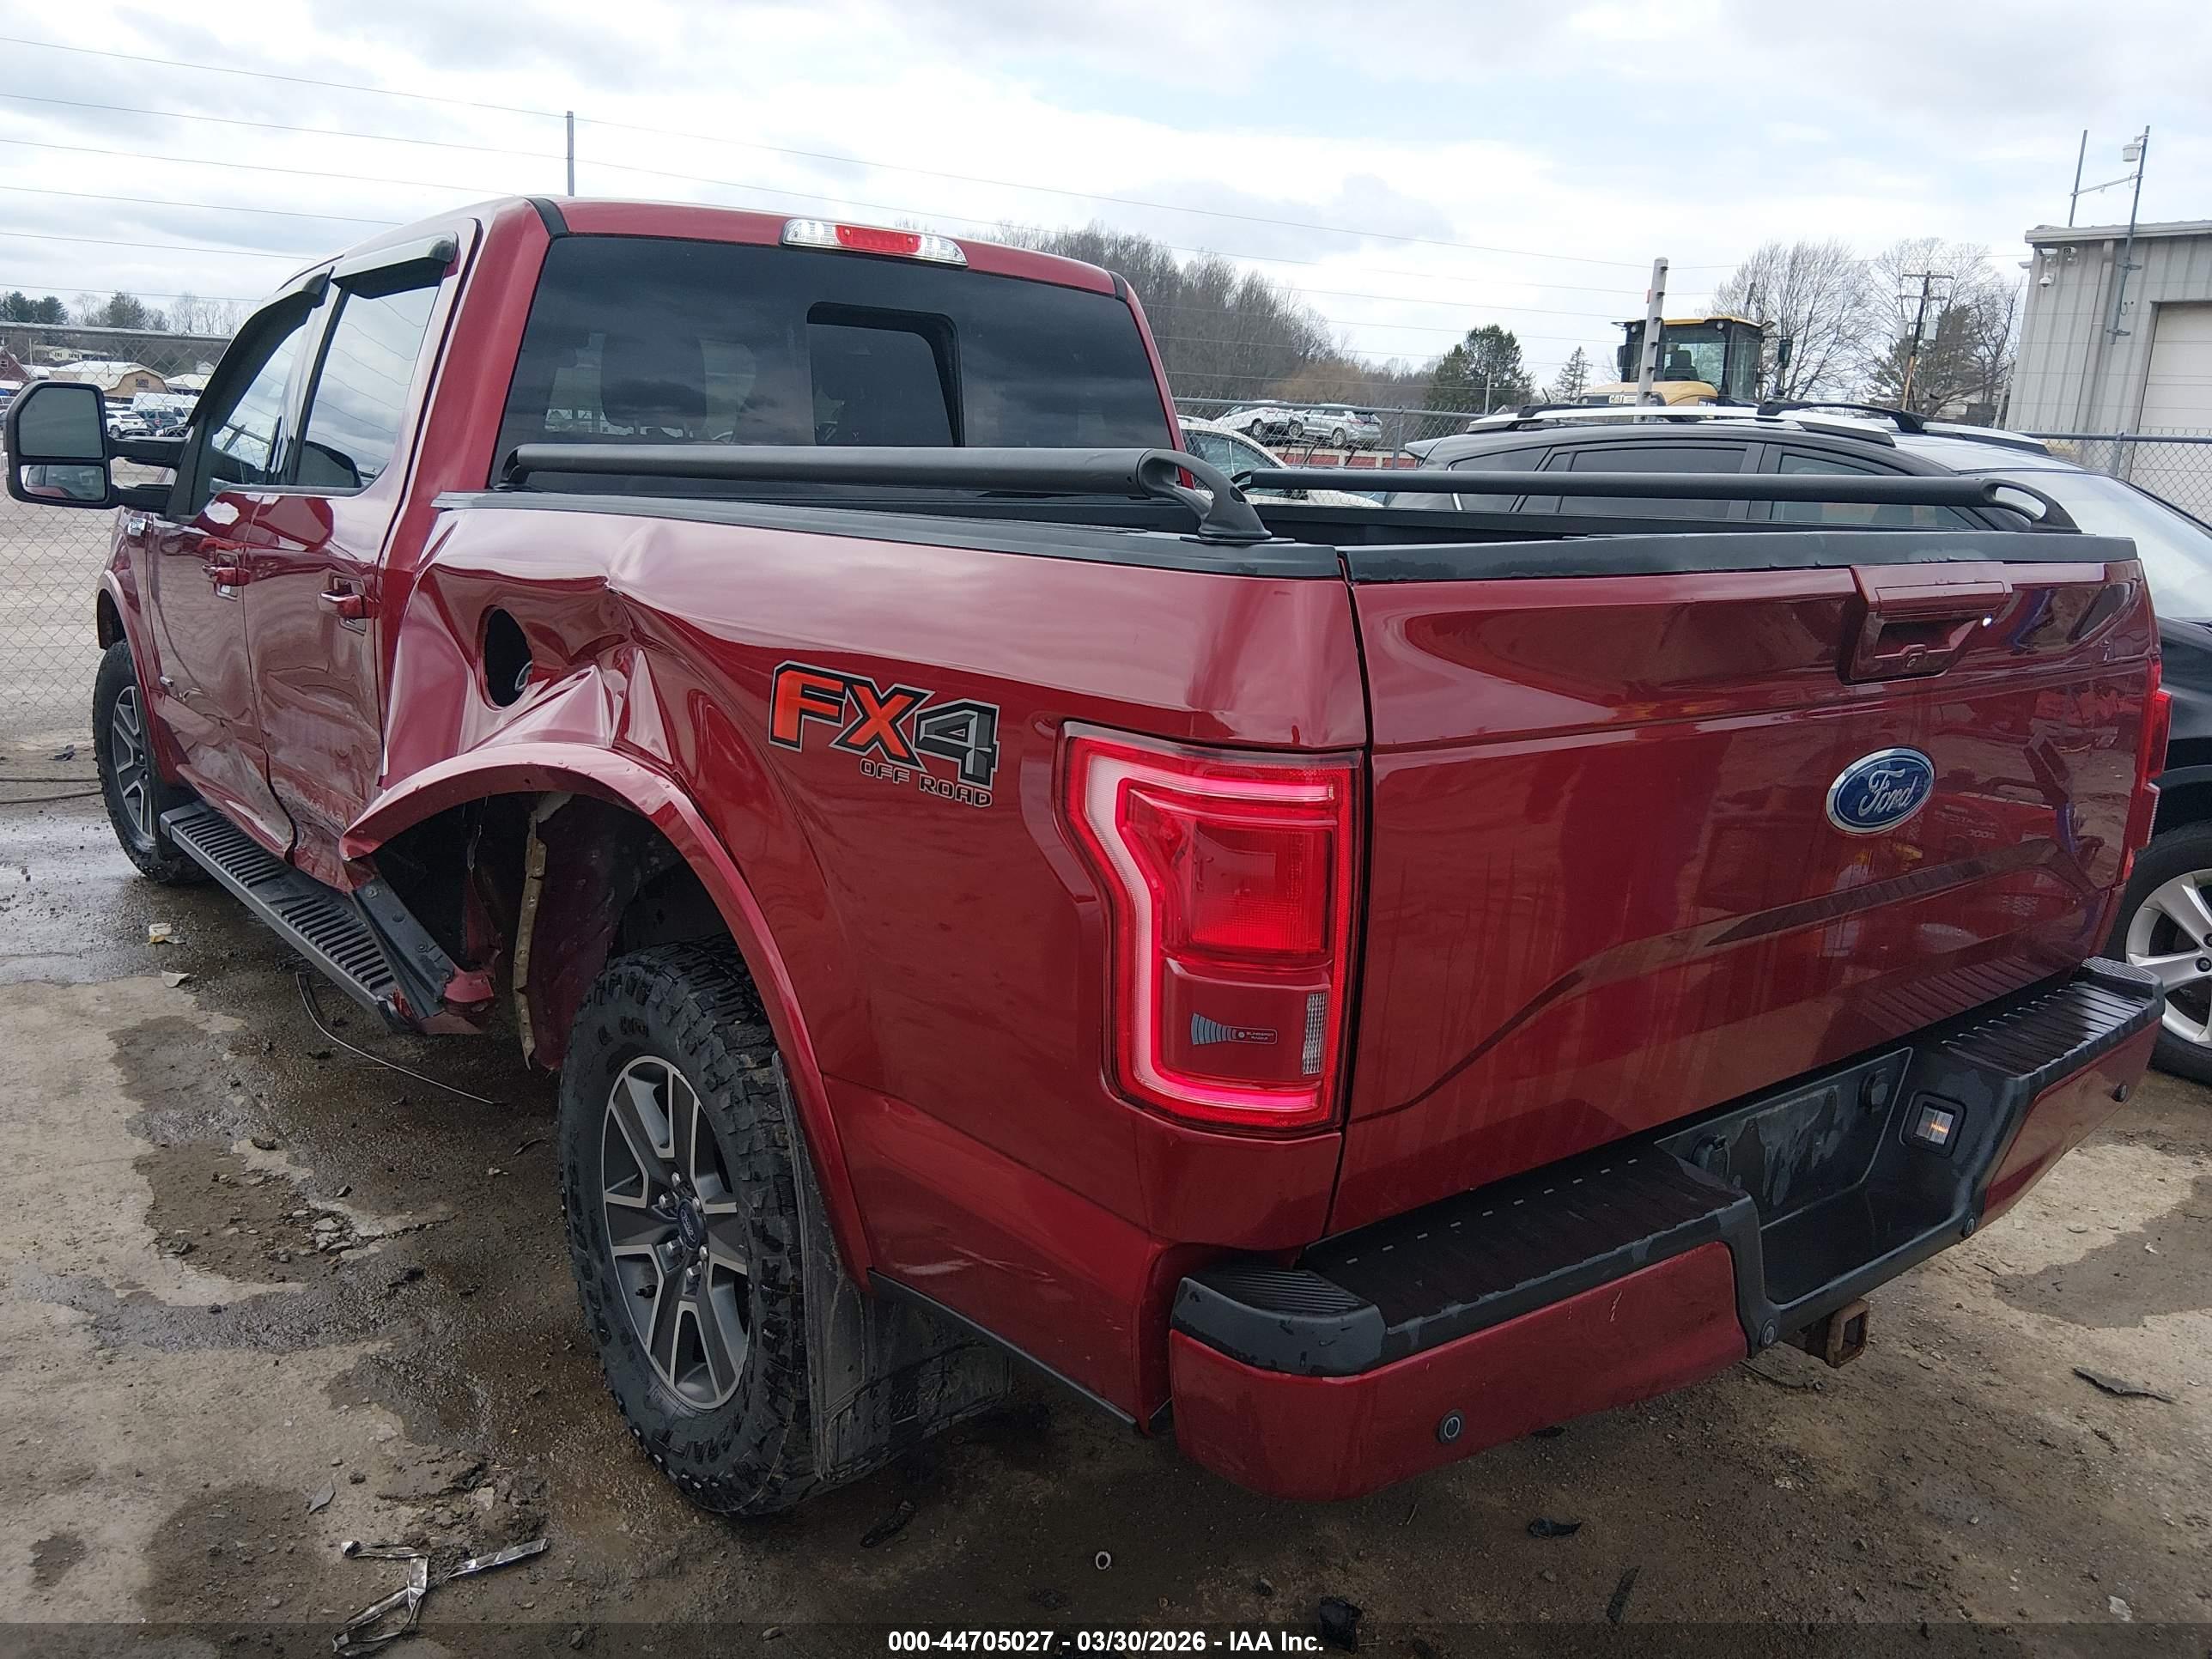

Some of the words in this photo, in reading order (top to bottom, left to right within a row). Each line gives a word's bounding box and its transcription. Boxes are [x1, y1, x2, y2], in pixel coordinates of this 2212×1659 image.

[769, 659, 1000, 790] FX4
[858, 757, 910, 784] OFF
[919, 773, 993, 808] ROAD
[1857, 768, 1918, 817] Ford
